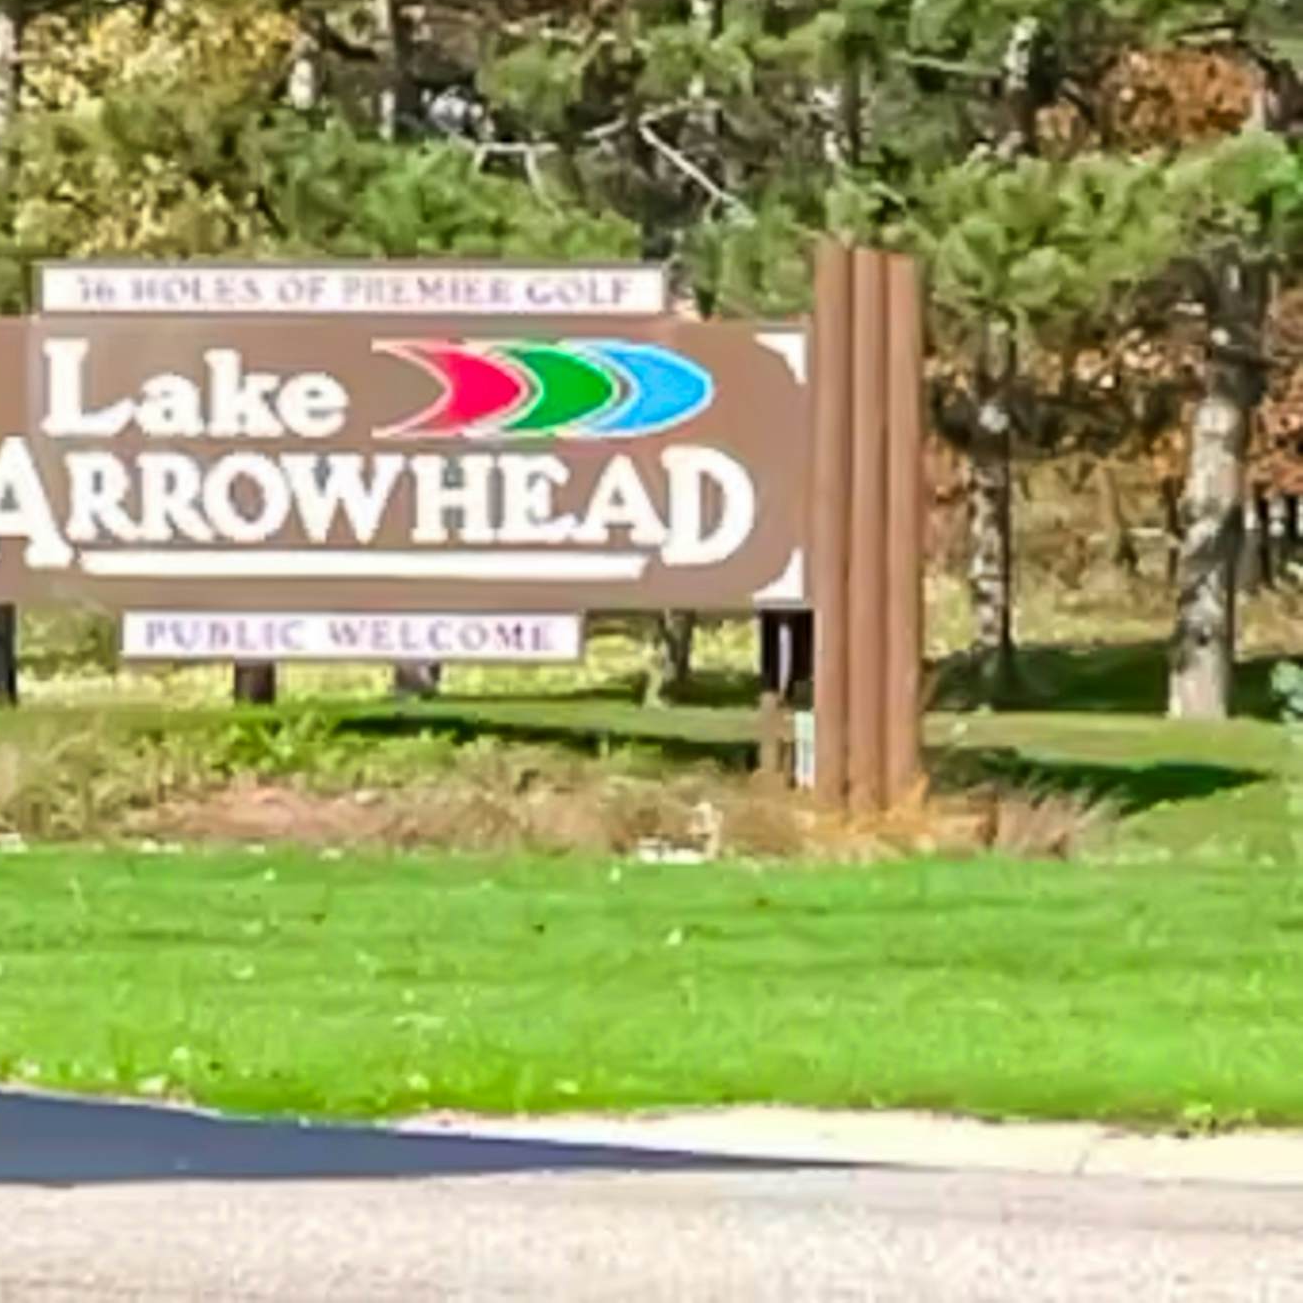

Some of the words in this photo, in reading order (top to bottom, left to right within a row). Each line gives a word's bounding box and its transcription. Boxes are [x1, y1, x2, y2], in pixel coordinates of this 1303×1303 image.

[129, 275, 263, 303] HOLES
[277, 275, 327, 303] OF
[341, 275, 514, 303] PREMIER
[525, 274, 631, 303] GOLF
[41, 337, 351, 440] Lake
[143, 618, 308, 651] PUBLIC
[327, 618, 557, 651] WELCOME
